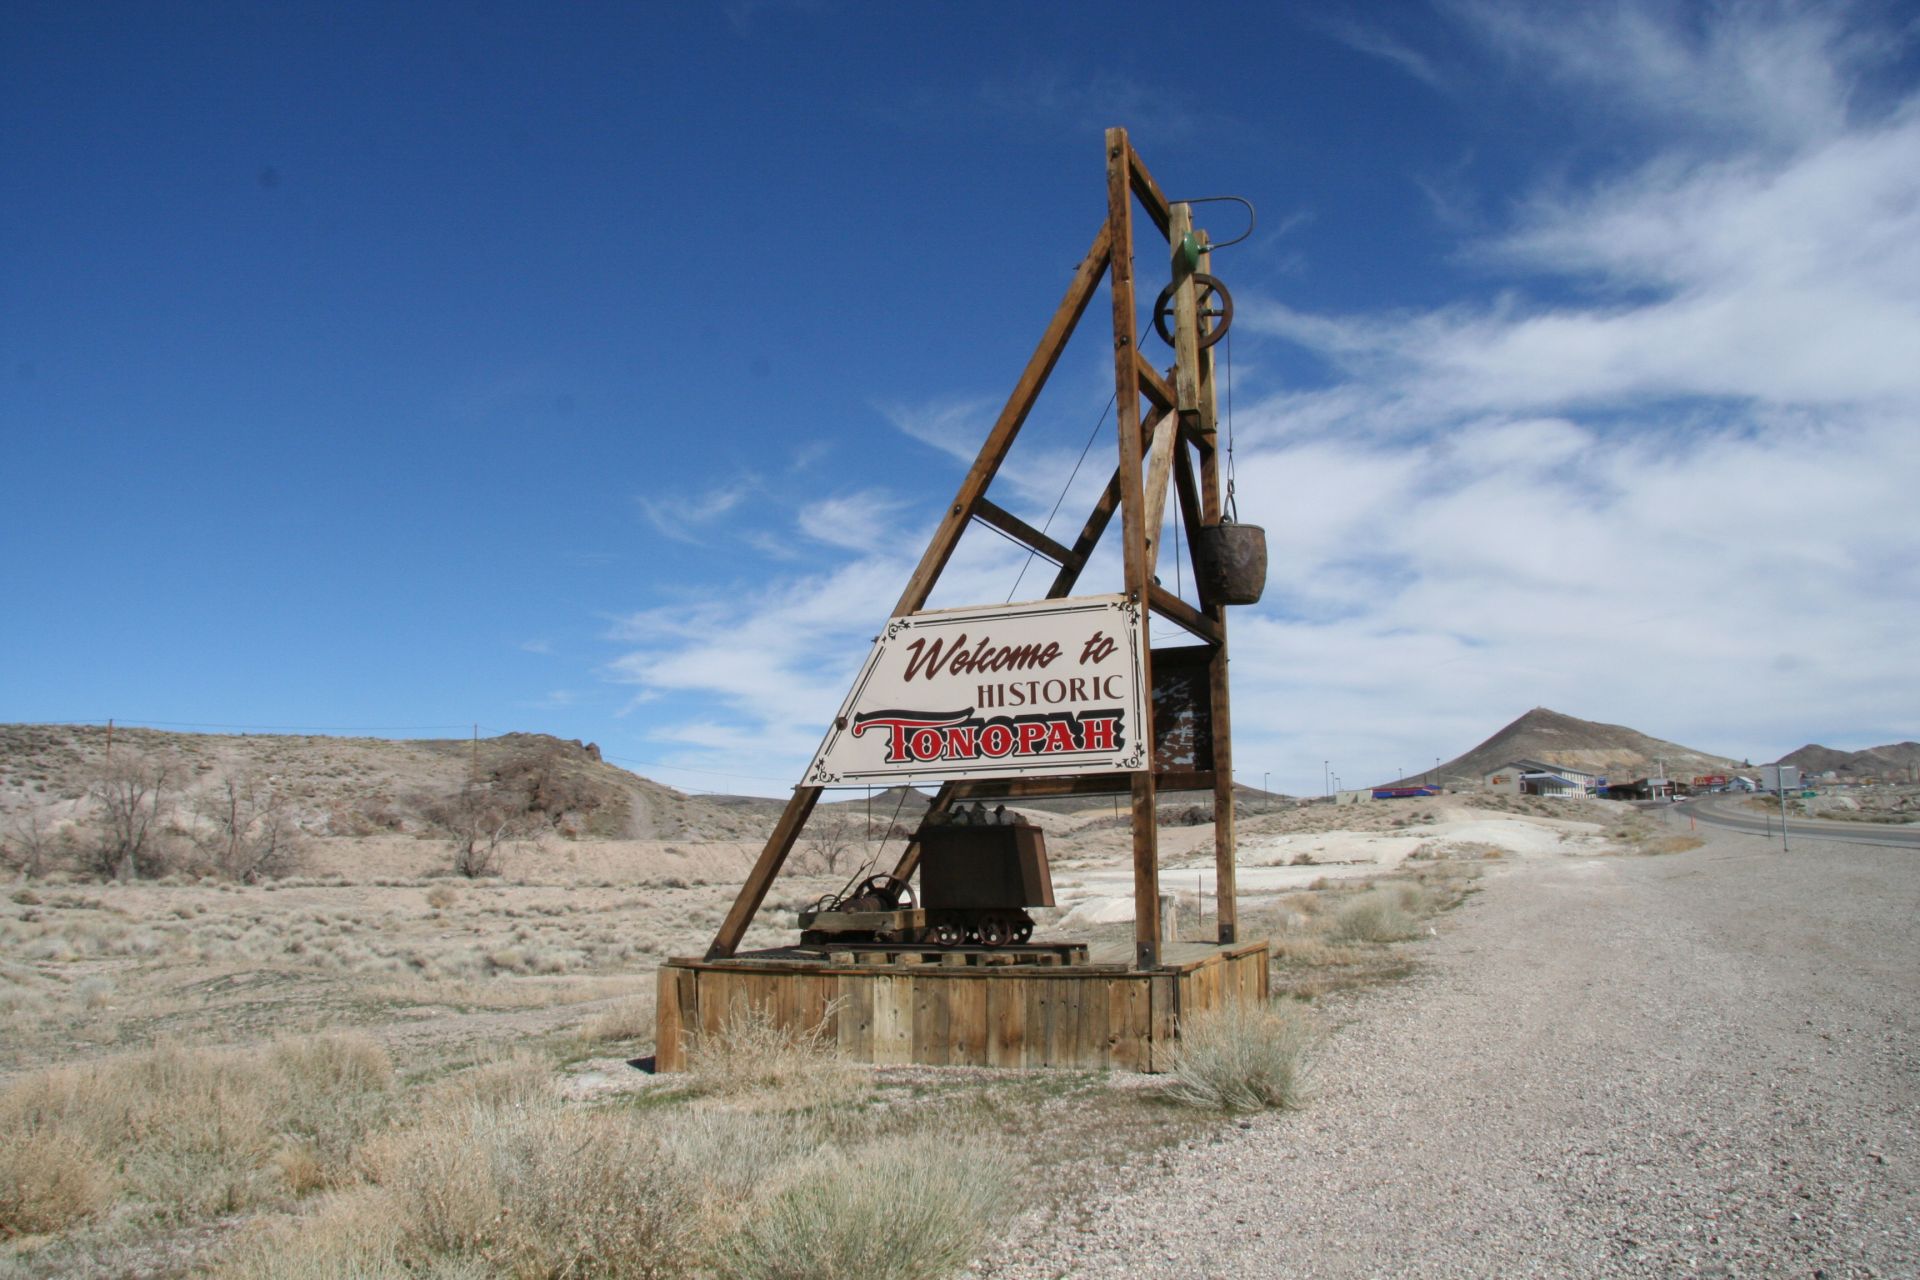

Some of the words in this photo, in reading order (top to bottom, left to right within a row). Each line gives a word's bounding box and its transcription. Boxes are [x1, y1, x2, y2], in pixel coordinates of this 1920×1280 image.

[903, 633, 1062, 682] Welcome
[1079, 631, 1118, 664] to
[977, 675, 1124, 708] HISTORIC
[852, 707, 1125, 763] TONOPAH
